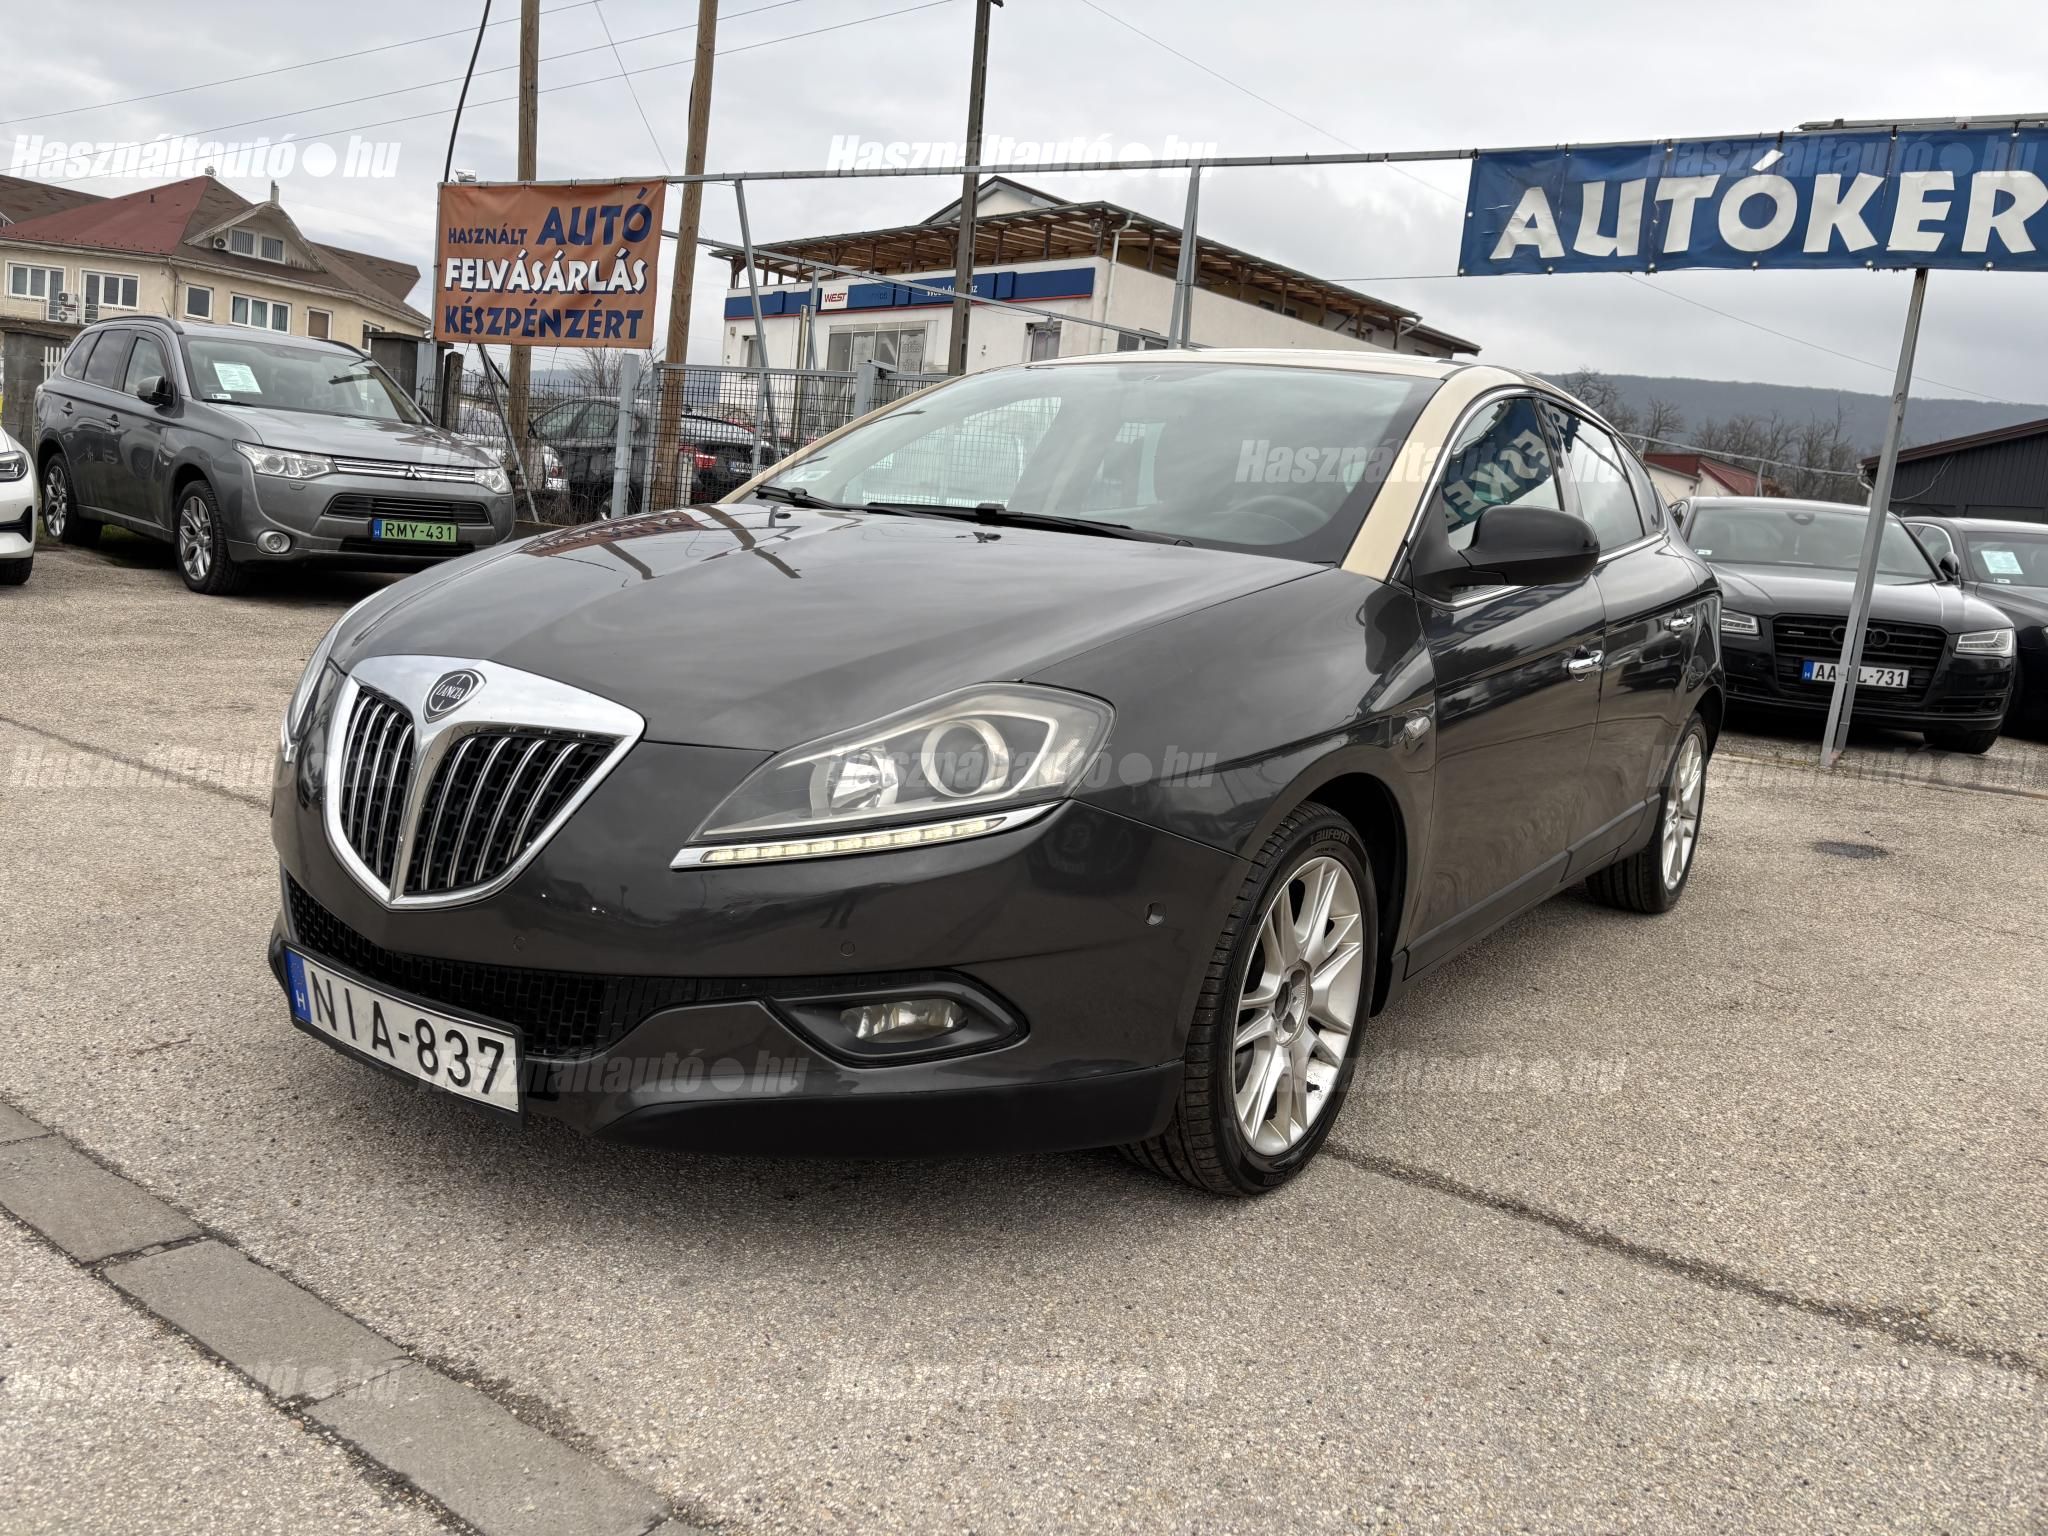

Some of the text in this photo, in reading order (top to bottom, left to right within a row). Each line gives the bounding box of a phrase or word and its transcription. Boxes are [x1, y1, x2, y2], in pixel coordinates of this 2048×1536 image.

[448, 187, 652, 245] HASZNÁLT AUTÓ
[1490, 148, 2048, 259] AUTÓKER
[444, 248, 648, 294] FELVÁSÁRLÁS
[445, 296, 643, 339] KÉSZPÉNZÉRT
[824, 292, 847, 303] WEST
[385, 522, 451, 540] RMY-431
[311, 970, 504, 1095] NIA-837
